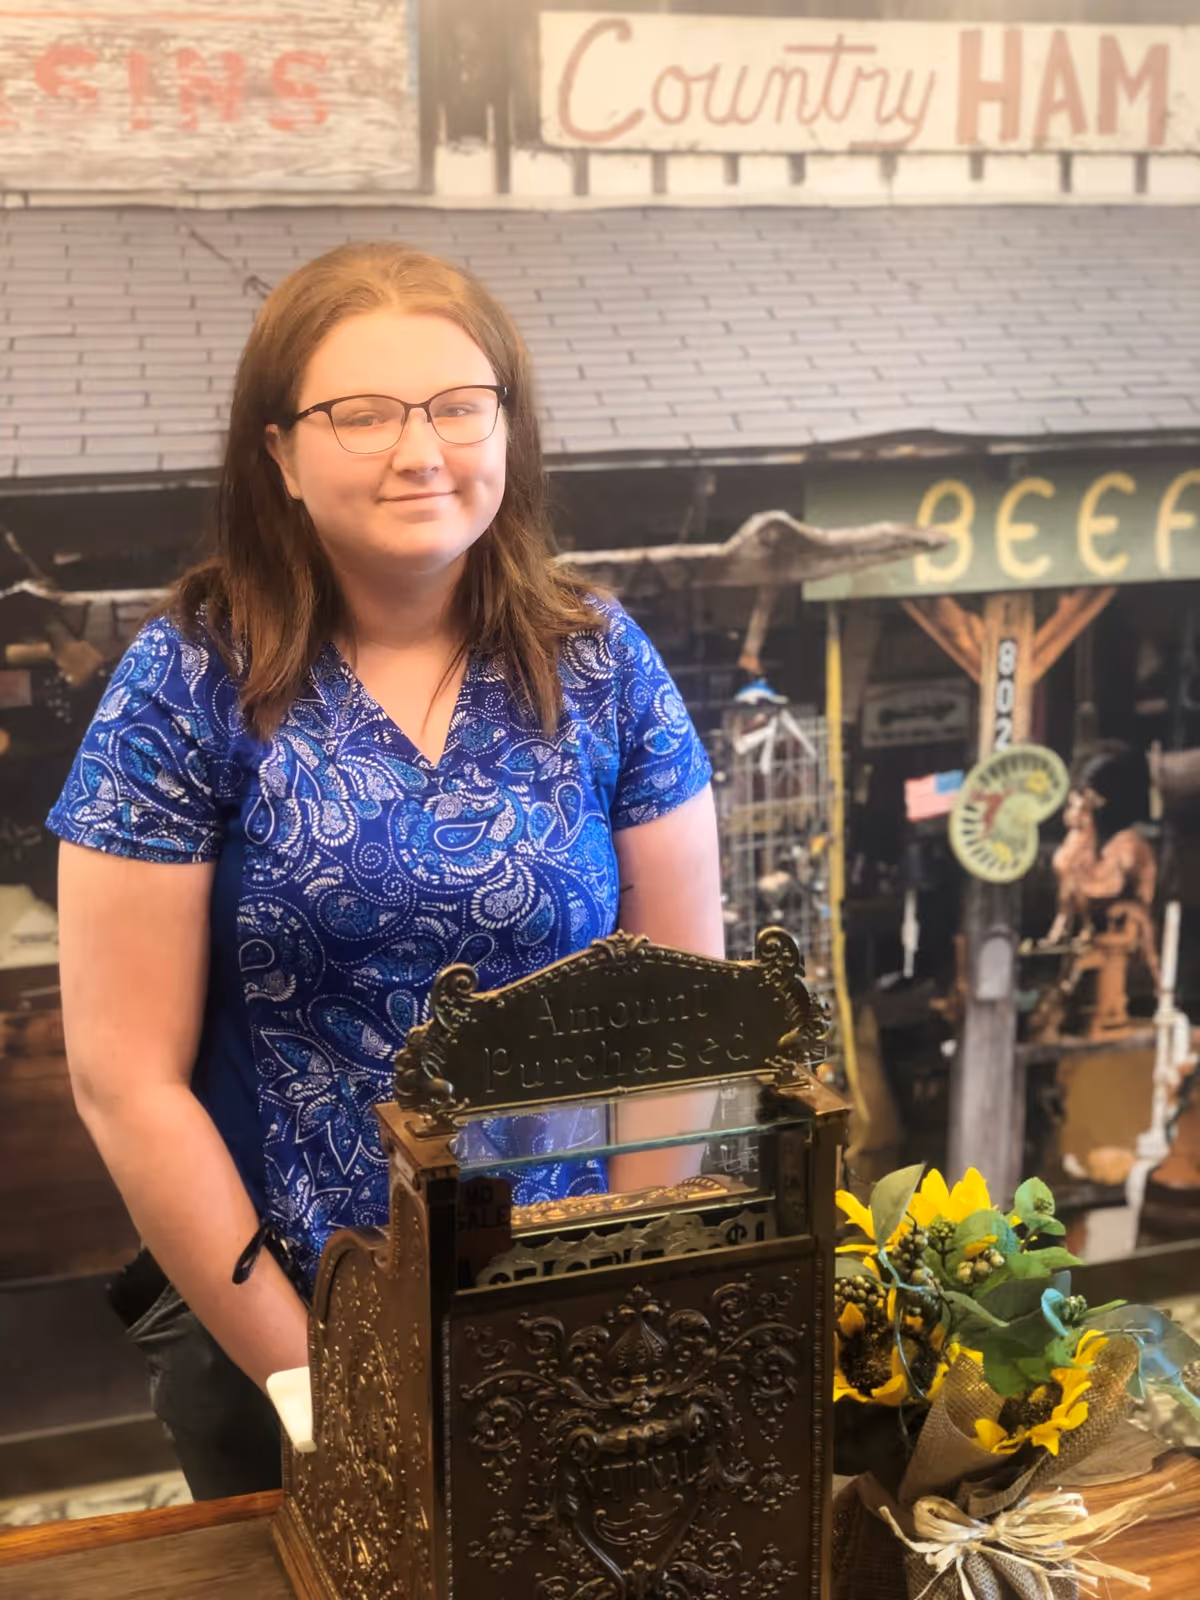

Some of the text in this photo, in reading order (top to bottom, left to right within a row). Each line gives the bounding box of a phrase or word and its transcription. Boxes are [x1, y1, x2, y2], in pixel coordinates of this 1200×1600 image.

[557, 18, 1171, 151] Country HAM
[914, 470, 1200, 585] BEEF
[484, 1021, 751, 1095] Purchased
[528, 983, 710, 1040] Amount
